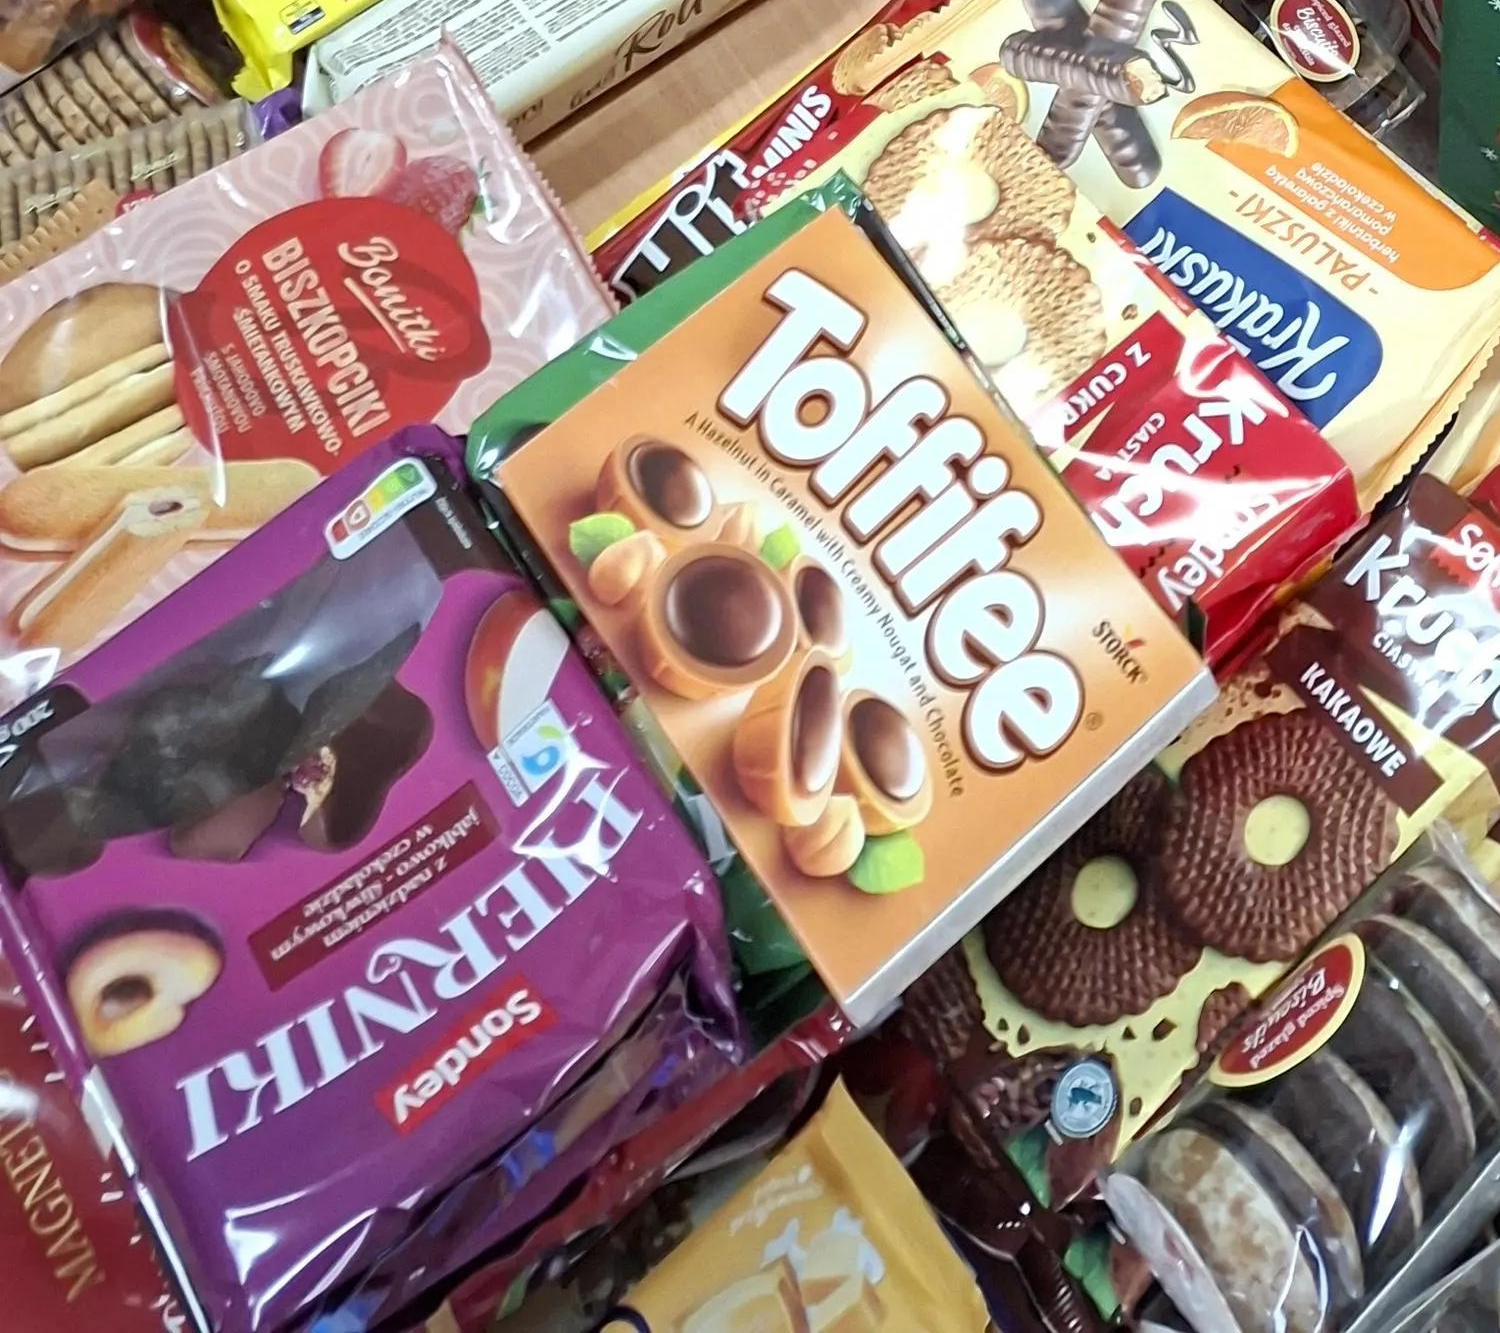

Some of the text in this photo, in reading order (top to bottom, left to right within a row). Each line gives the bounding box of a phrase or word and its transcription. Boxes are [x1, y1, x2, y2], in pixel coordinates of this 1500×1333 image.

[1234, 192, 1371, 291] PALUSZKI
[1264, 164, 1401, 263] herbatniki z galaretką
[1311, 162, 1397, 223] w czekoladzie
[234, 259, 251, 275] O
[241, 274, 282, 332] SMAKU
[336, 235, 443, 362] Bonitki
[1136, 226, 1351, 401] Krakuski
[261, 236, 391, 438] BISZKOPCIKI
[1064, 340, 1152, 427] Z CUKR
[1091, 398, 1268, 544] Kruch
[1094, 412, 1166, 481] CIASTA
[717, 267, 1085, 773] Toffifee
[684, 411, 964, 798] A Hazelnut in Caramel with Creamy Nougat and Chocolate
[1092, 619, 1143, 685] STORCK
[1300, 659, 1407, 778] KAKAOWE
[303, 824, 434, 918] w czekoladzie
[434, 855, 447, 873] z
[175, 769, 645, 1163] PIERNIKI
[391, 987, 543, 1124] Sondey
[0, 1111, 106, 1303] MAGNET
